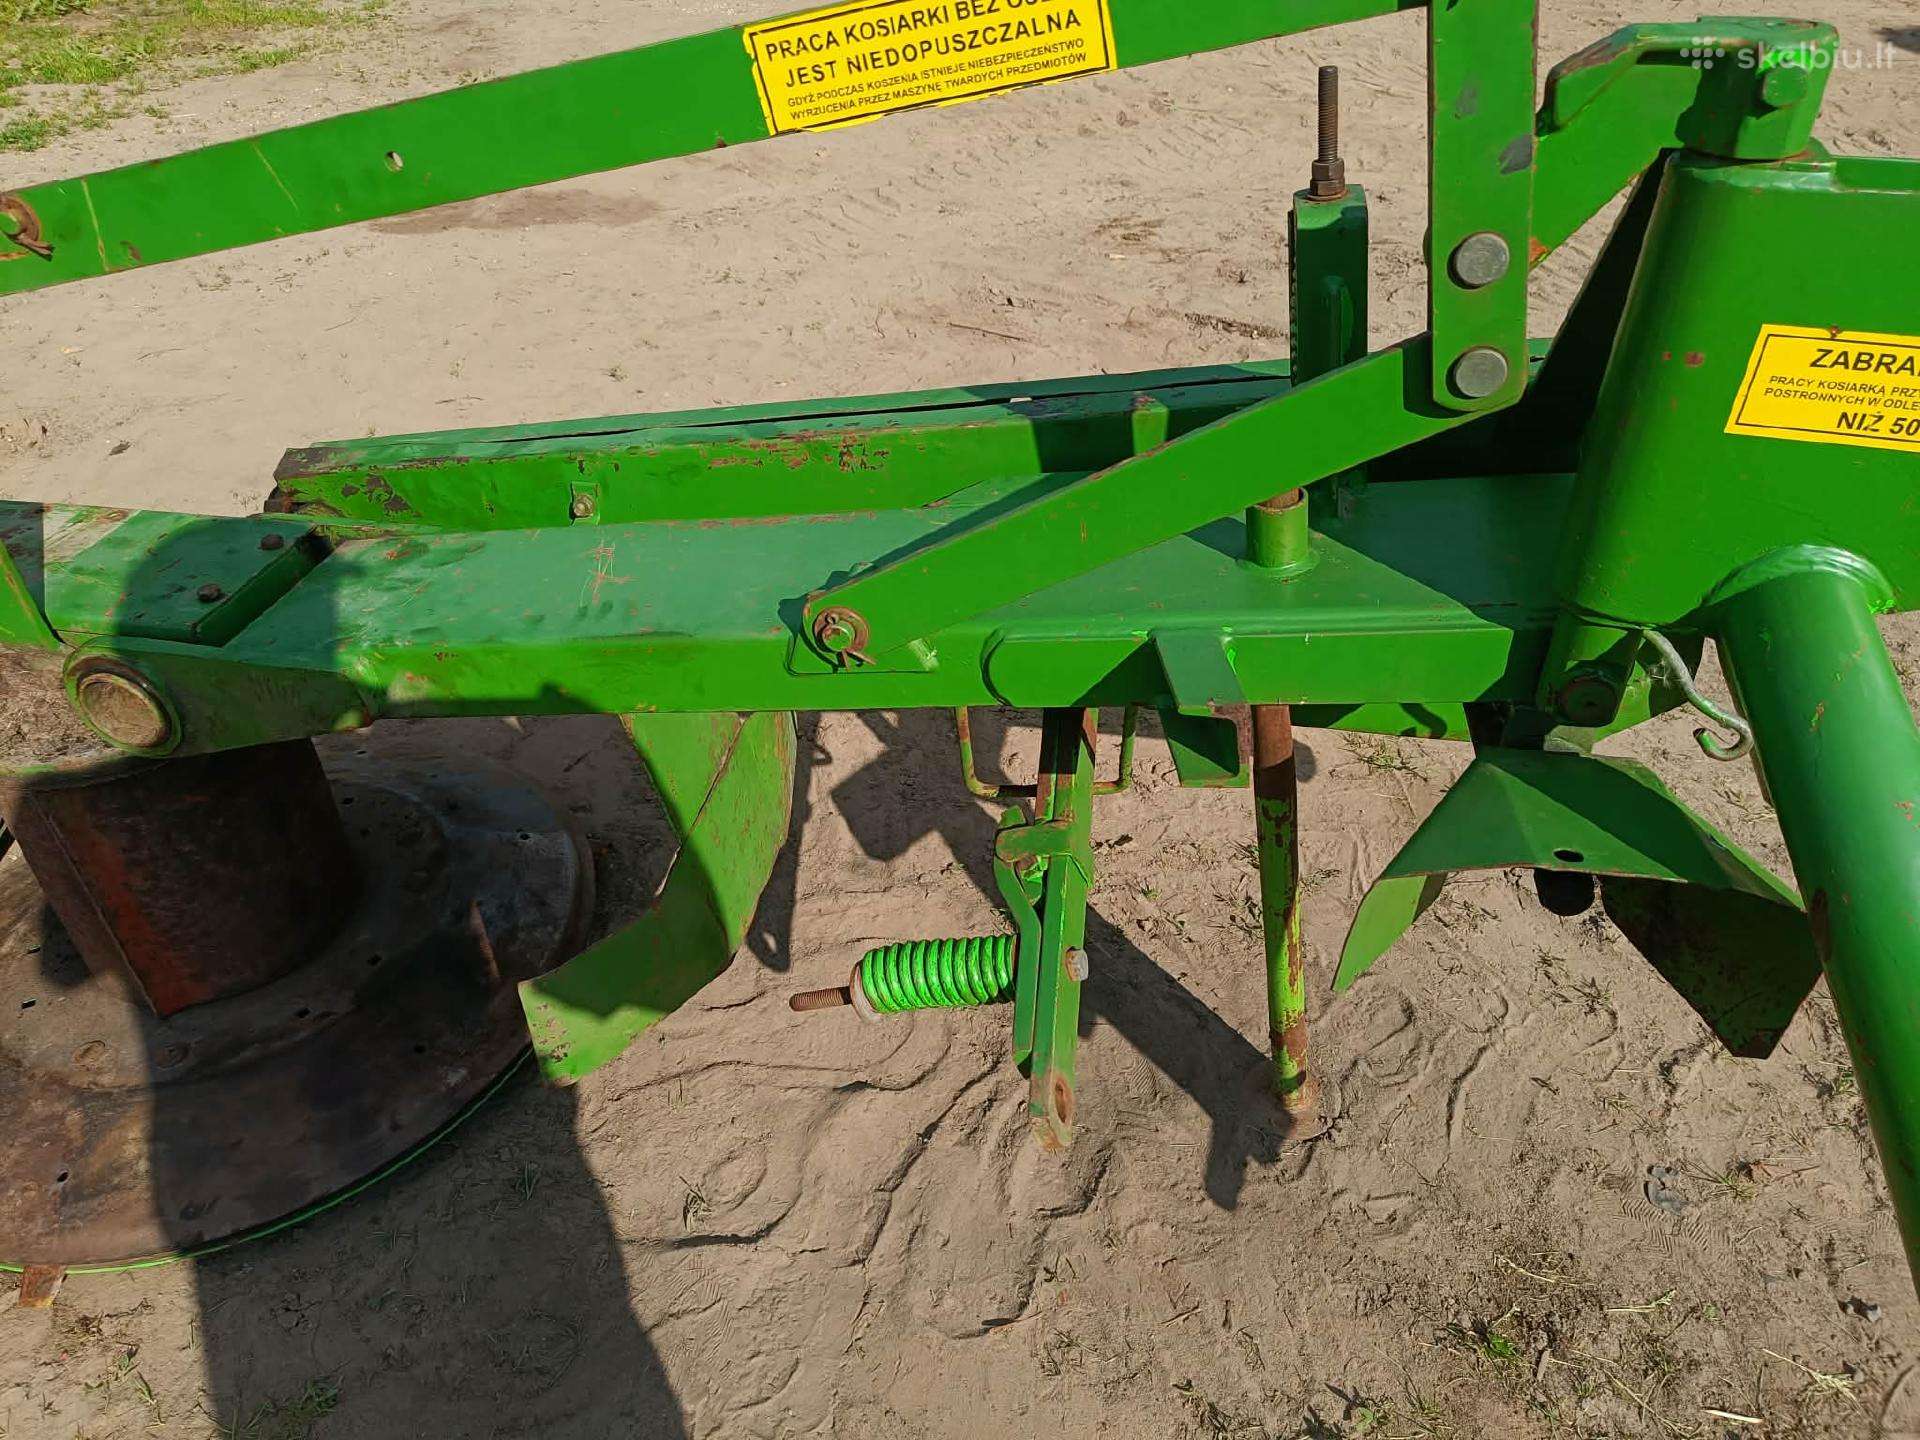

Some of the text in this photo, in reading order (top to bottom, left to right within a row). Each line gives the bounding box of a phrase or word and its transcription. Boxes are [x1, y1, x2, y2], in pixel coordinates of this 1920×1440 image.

[766, 0, 1000, 61] PRACA KOSIARKI BEZ
[786, 9, 1081, 87] JEST NIEDOPUSZCZALNA
[790, 100, 857, 120] WYRZUCENIA
[858, 92, 891, 106] PRZEZ
[945, 70, 1003, 89] TWARDYCH
[1006, 52, 1087, 76] PRZEDMIOTÓW
[816, 83, 864, 101] PODCZAS
[867, 72, 919, 90] KOSZENIA
[920, 61, 966, 79] ISTNIEJE
[1810, 348, 1920, 376] ZABRA
[1764, 387, 1865, 406] POSTRONNYCH
[1867, 396, 1882, 406] W
[1769, 375, 1815, 388] PRACY
[1837, 411, 1885, 432] NIŻ
